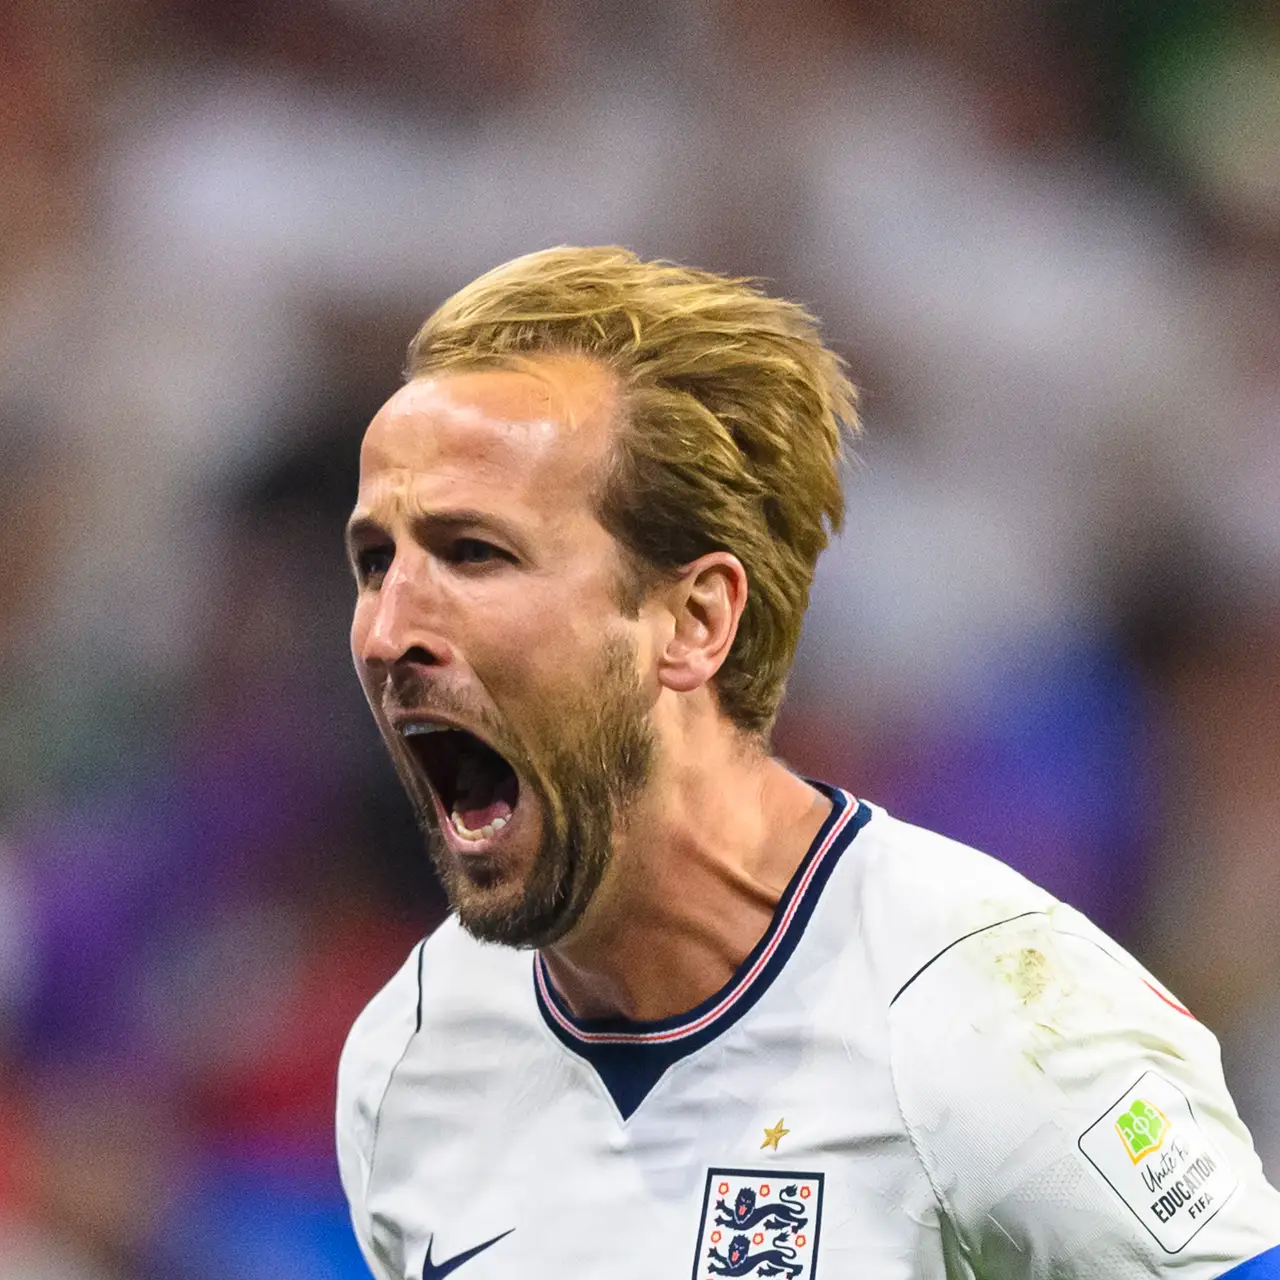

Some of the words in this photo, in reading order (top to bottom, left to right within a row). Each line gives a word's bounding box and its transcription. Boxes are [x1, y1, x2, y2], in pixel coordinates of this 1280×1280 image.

[1140, 1151, 1177, 1193] Unite
[1150, 1152, 1217, 1224] EDUCATION
[1188, 1192, 1214, 1219] FIFA
